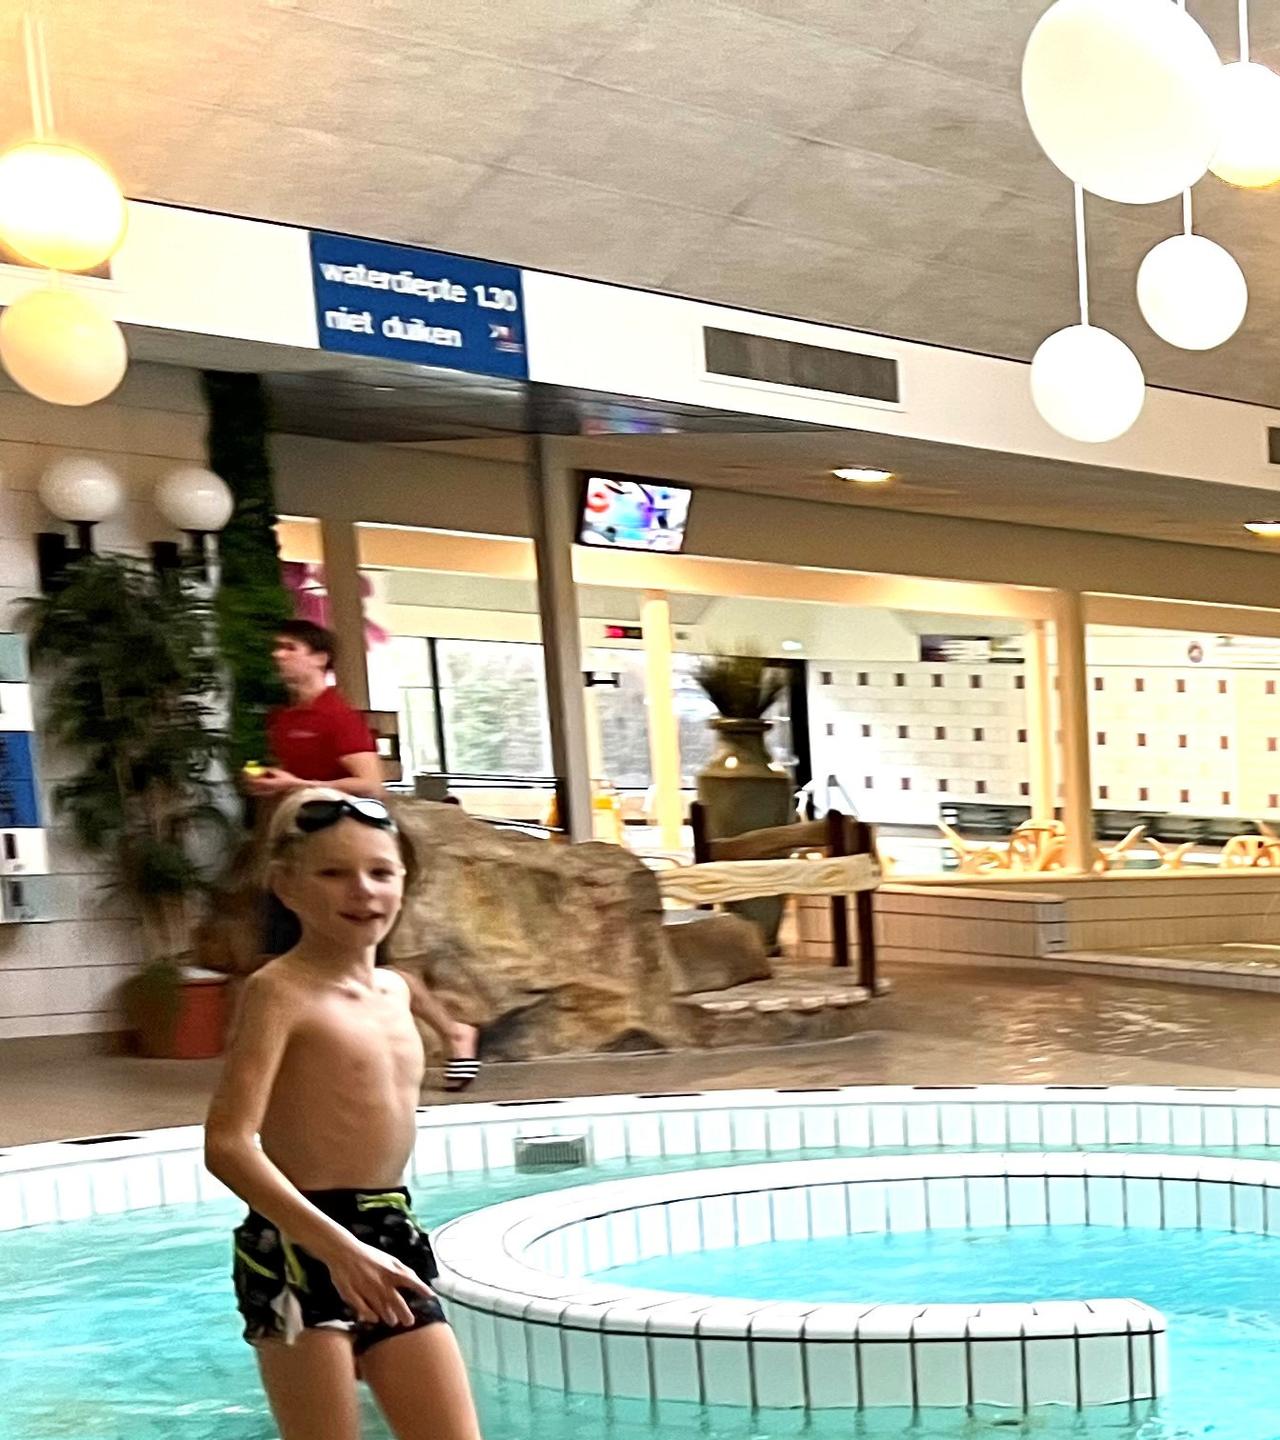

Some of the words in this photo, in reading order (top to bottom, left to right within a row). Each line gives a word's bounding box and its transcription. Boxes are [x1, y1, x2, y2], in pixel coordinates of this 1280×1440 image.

[319, 262, 468, 303] waterdiepte
[325, 306, 374, 334] niet
[382, 315, 462, 347] duiken
